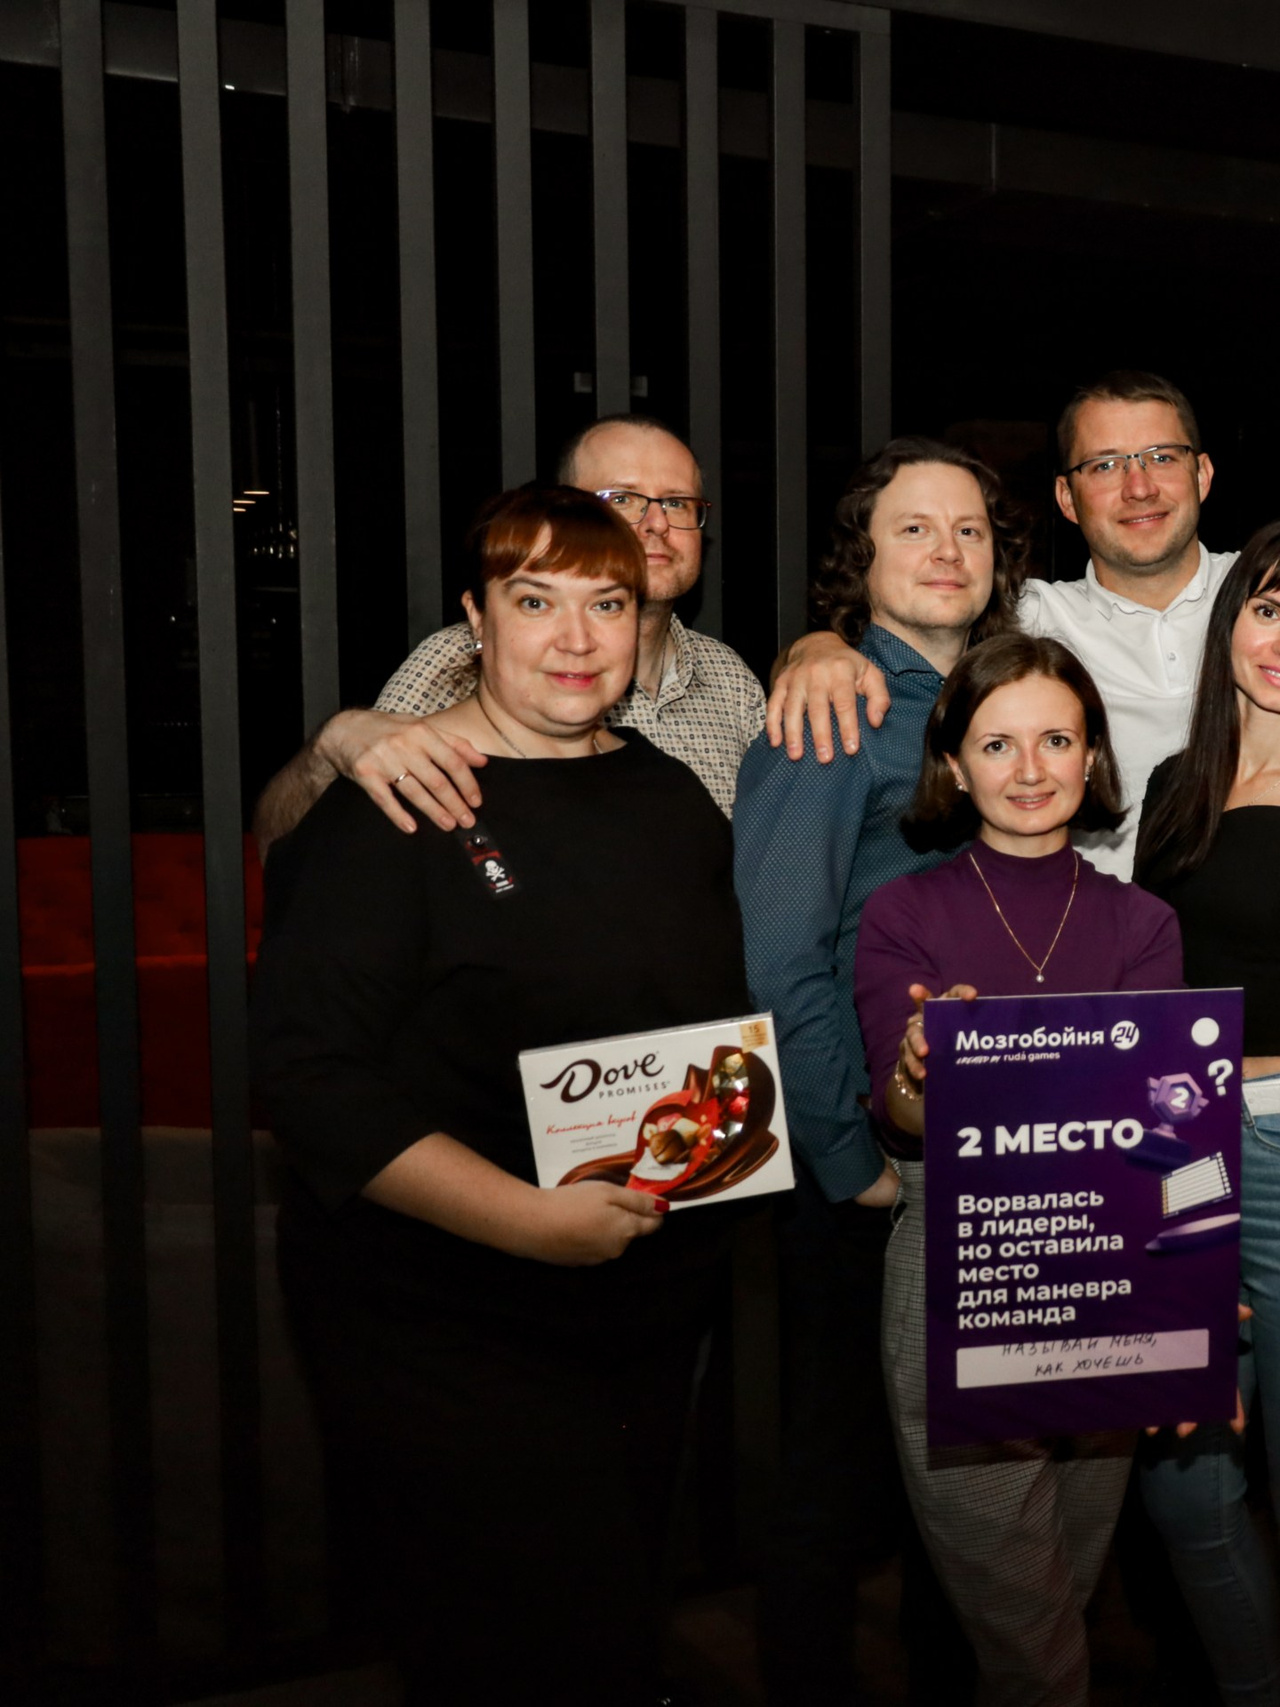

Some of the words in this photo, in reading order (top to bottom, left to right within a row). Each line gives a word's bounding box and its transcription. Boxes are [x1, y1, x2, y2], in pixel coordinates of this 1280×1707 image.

[955, 1027, 1105, 1051] Мозгобойня
[1027, 1052, 1061, 1063] games
[540, 1052, 665, 1103] Dove
[599, 1081, 668, 1099] PROMISES
[1171, 1087, 1190, 1109] 2
[957, 1127, 983, 1158] 2
[995, 1118, 1144, 1155] МЕСТО
[958, 1191, 1105, 1217] Ворвалась
[958, 1221, 973, 1237] в
[980, 1213, 1096, 1237] лидеры,
[958, 1242, 992, 1261] но
[999, 1234, 1125, 1259] оставила
[958, 1261, 1040, 1284] место
[957, 1288, 1008, 1310] для
[1016, 1279, 1133, 1303] маневра
[958, 1305, 1077, 1330] команда
[1034, 1361, 1064, 1377] КАК
[1072, 1353, 1144, 1373] ХОЧЕШЬ
